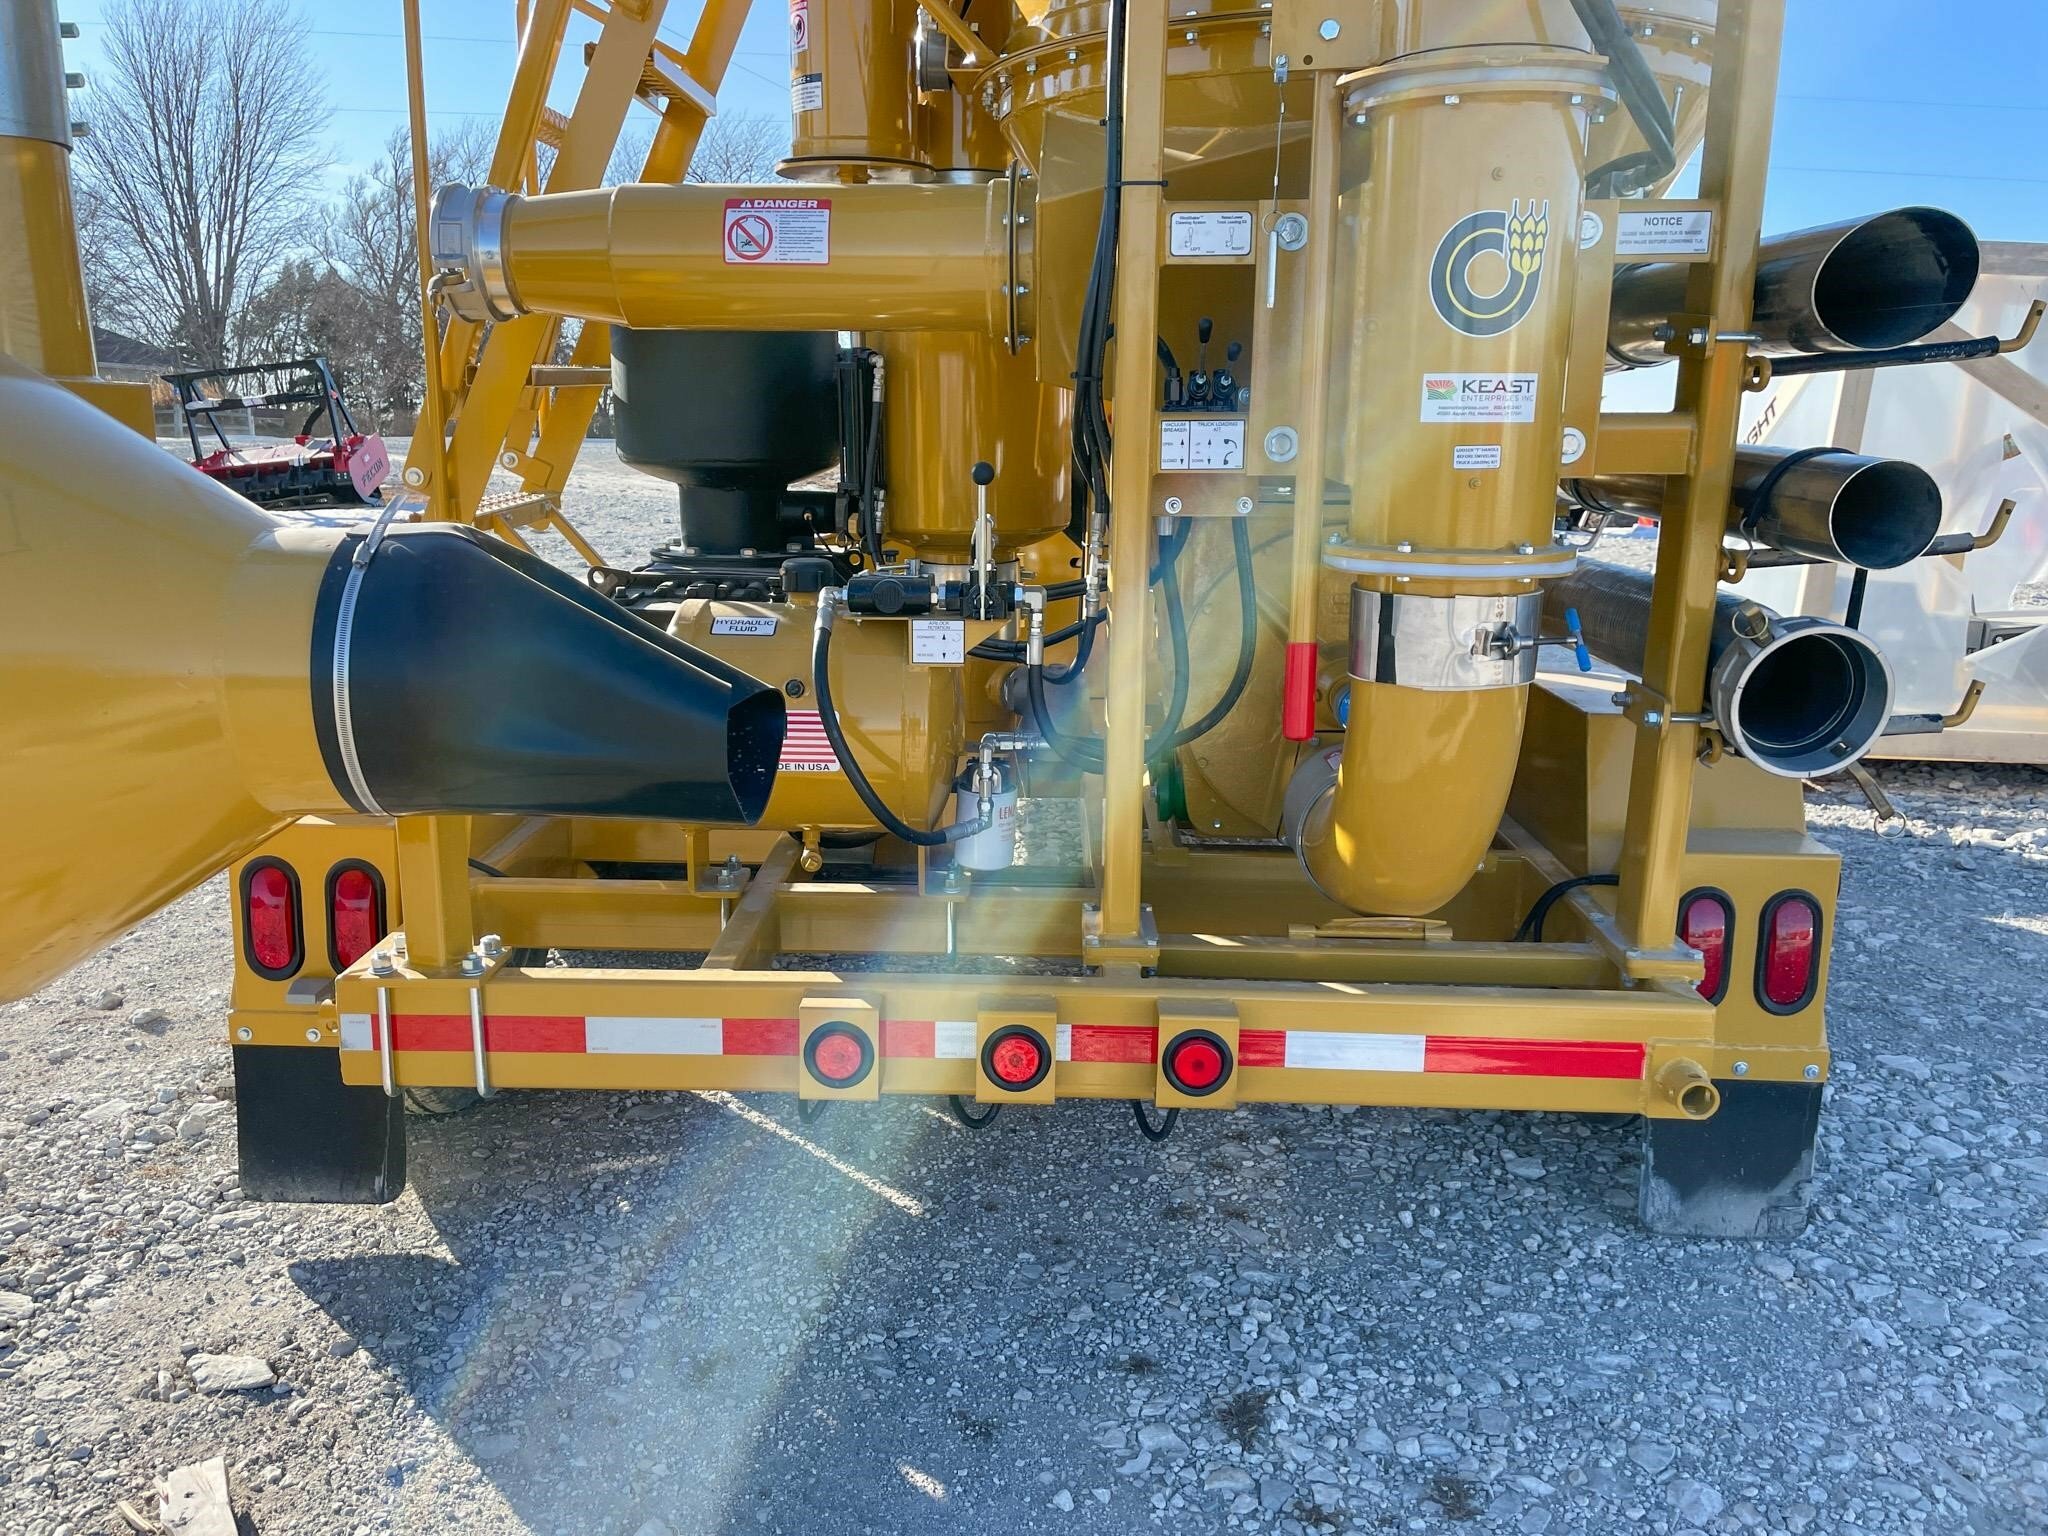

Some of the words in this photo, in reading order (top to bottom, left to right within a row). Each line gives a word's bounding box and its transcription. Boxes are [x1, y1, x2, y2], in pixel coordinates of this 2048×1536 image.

[753, 200, 818, 208] DANGER
[1644, 217, 1683, 226] NOTICE
[1462, 379, 1535, 394] KEAST
[1461, 394, 1519, 402] ENTERPRISES
[1521, 394, 1534, 402] INC
[1743, 395, 1777, 445] GHT
[808, 763, 830, 771] USA
